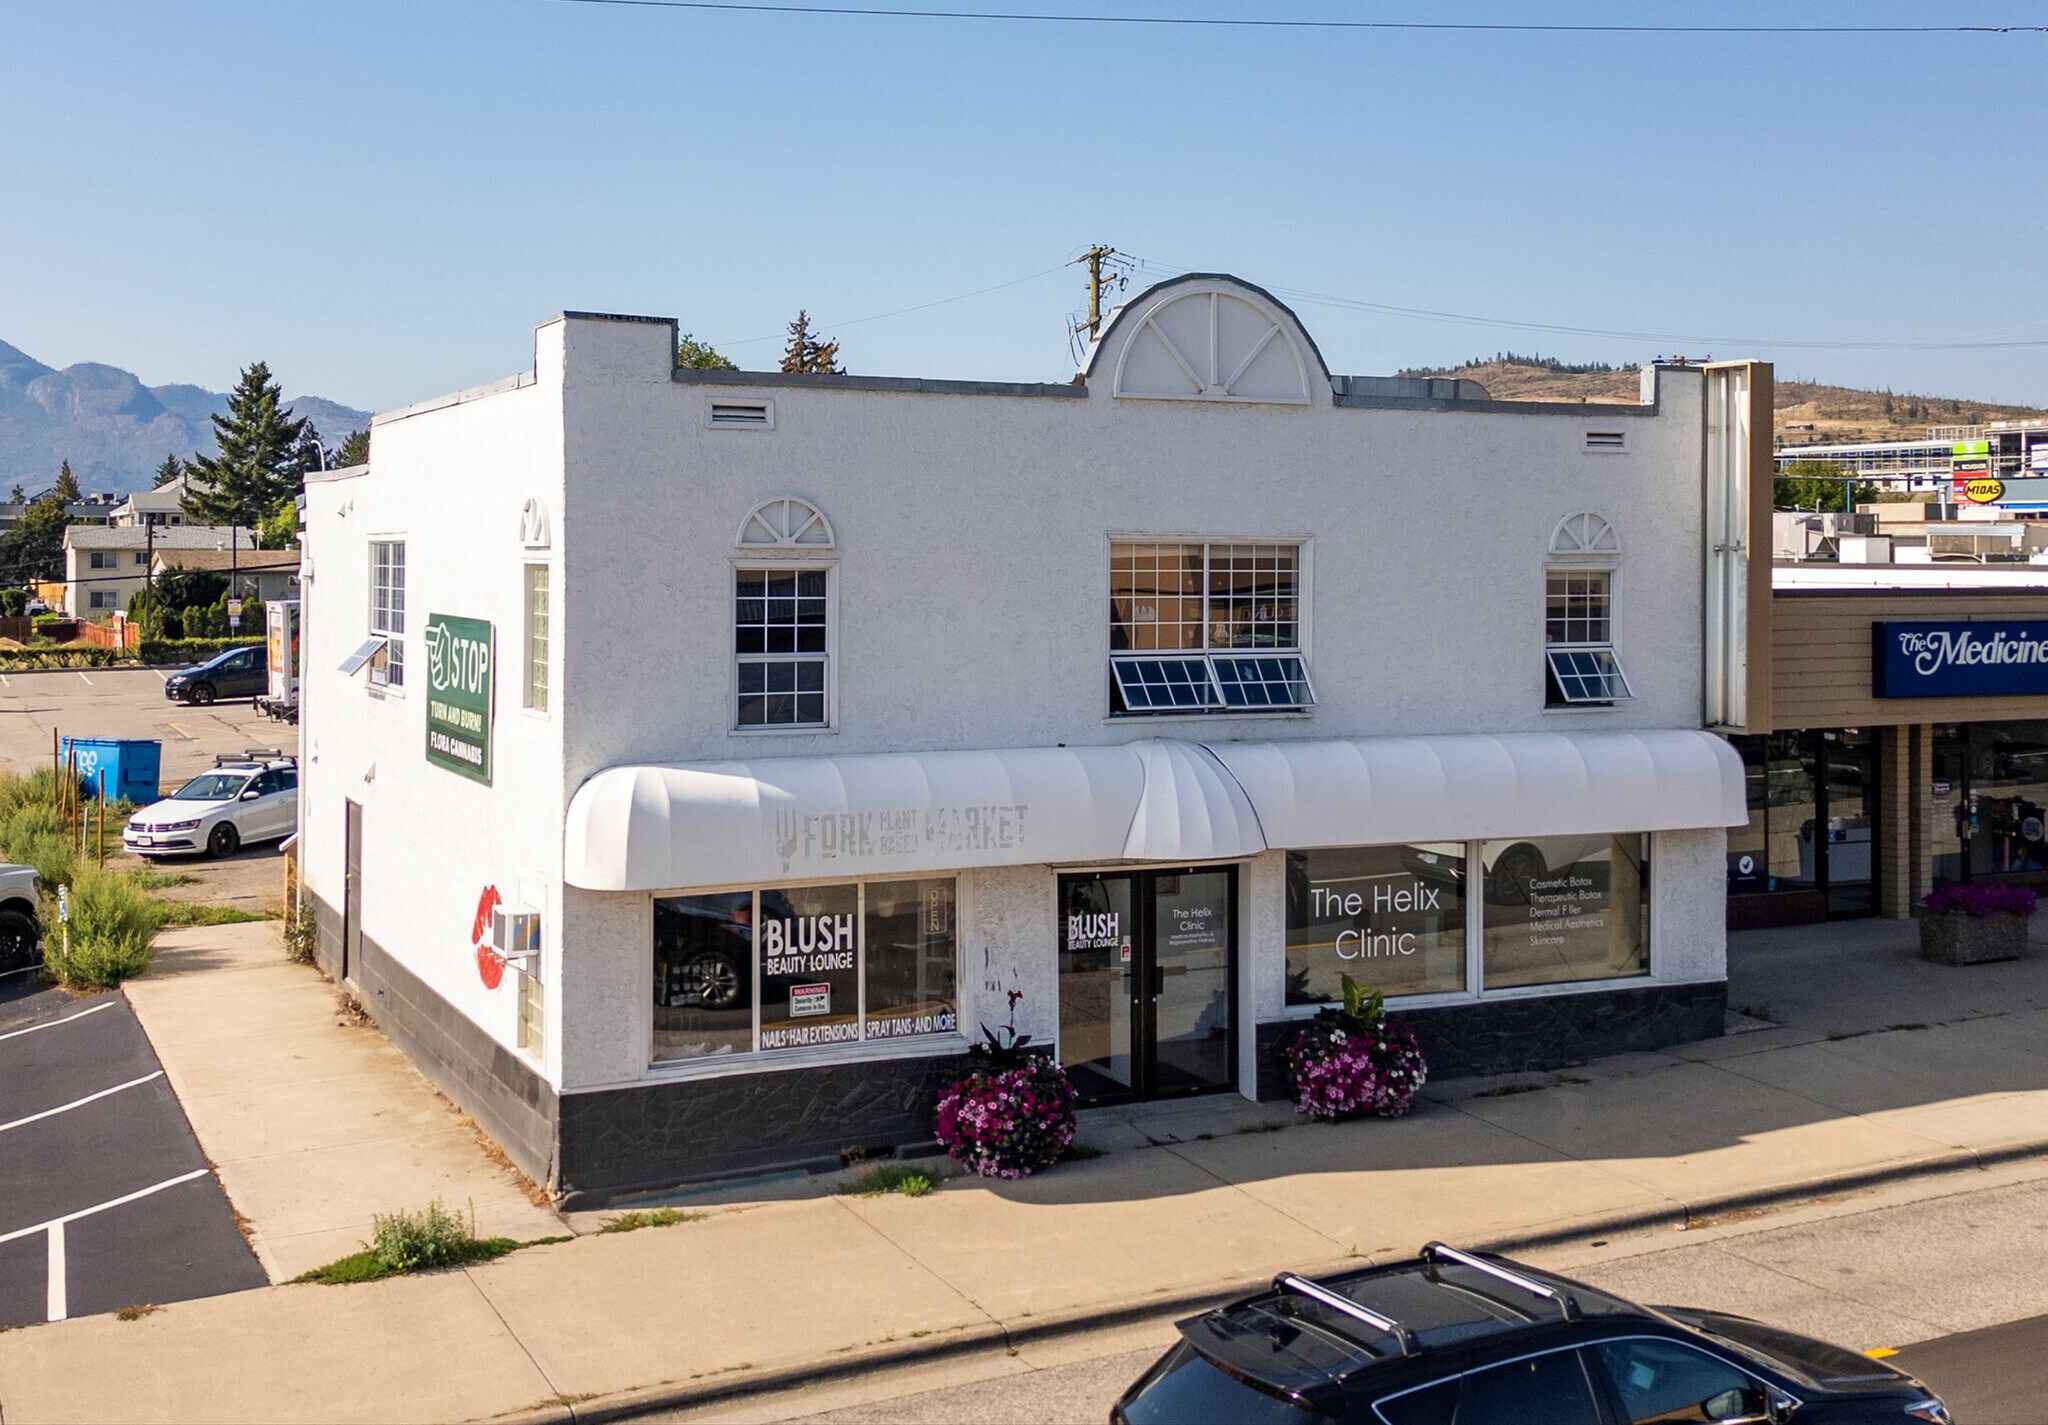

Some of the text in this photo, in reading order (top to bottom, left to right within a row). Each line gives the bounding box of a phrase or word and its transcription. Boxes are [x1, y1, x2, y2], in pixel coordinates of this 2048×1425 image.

[1967, 485, 2000, 495] MIDAS
[1898, 632, 1927, 656] The
[451, 637, 488, 694] STOP
[430, 701, 482, 733] TURN AND BURN!
[430, 731, 482, 766] FLORA CANNABIS
[803, 812, 874, 858] FORK
[1529, 876, 1593, 889] Cosmetic Botox
[1311, 881, 1440, 918] The Helix
[1529, 890, 1602, 904] Therapeutic Botox
[930, 890, 939, 931] OPEN
[1172, 907, 1213, 919] The Helix
[1529, 904, 1582, 918] Dermal Fller
[767, 914, 853, 956] BLUSH
[1068, 912, 1119, 940] BLUSH
[1180, 920, 1205, 931] Clinic
[1529, 918, 1603, 931] Medical Aesthetics
[1068, 937, 1119, 950] BEAUTY LOUNGE
[1335, 926, 1416, 960] Clinic
[767, 952, 853, 976] BEAUTY LOUNGE
[794, 986, 827, 996] WARNING
[810, 1022, 859, 1043] EXTENSIONS
[867, 1020, 890, 1038] SPRAY
[933, 1013, 956, 1032] MORE
